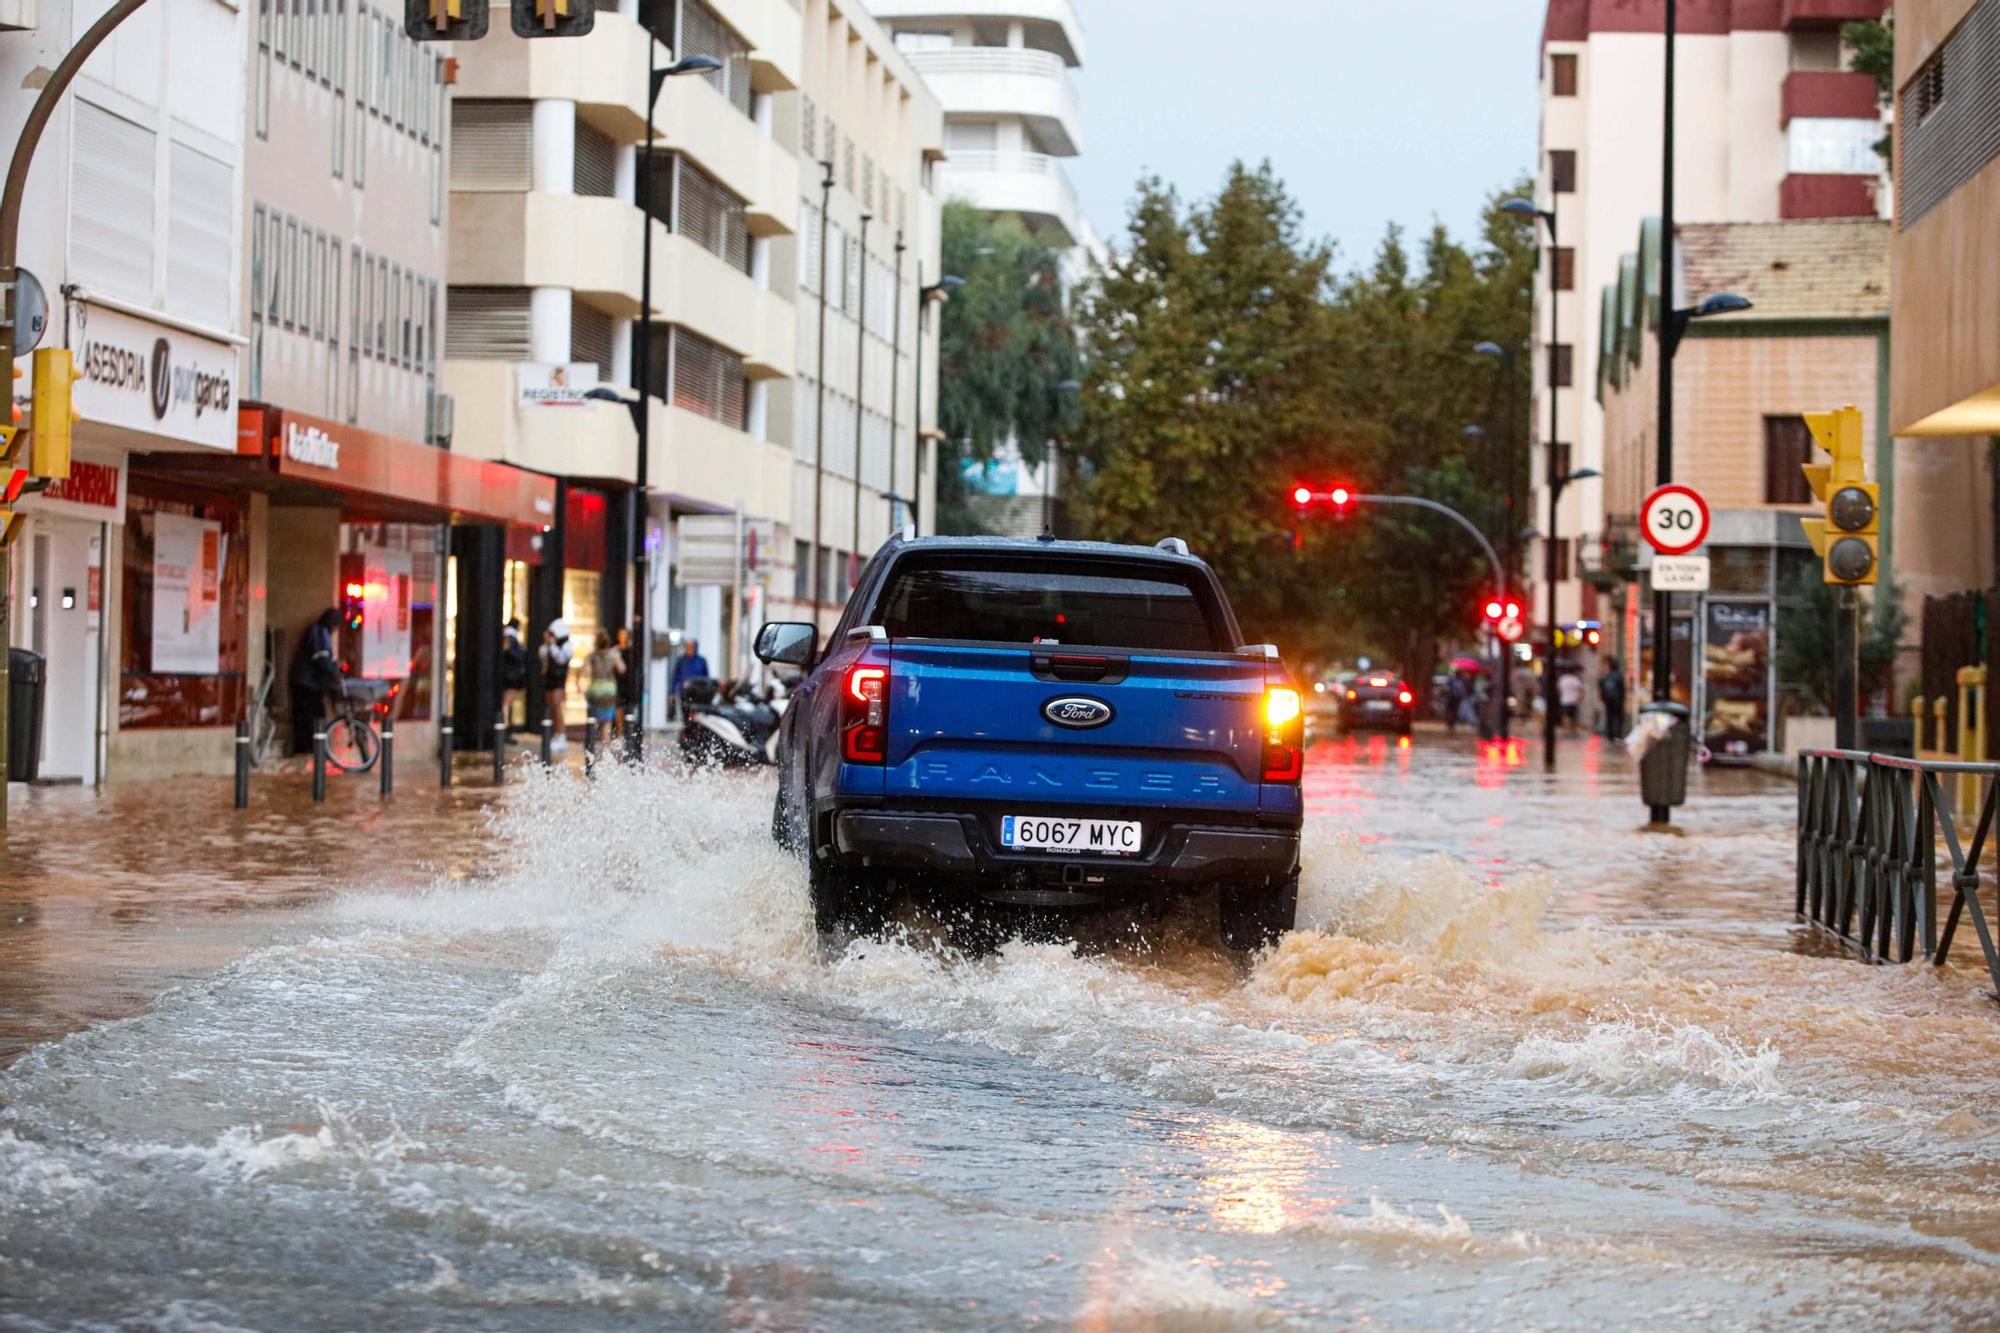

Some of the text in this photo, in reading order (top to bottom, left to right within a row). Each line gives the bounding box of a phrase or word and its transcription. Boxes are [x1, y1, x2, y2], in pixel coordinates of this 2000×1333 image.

[84, 341, 146, 392] ASESORIA
[1658, 508, 1694, 530] 30
[1060, 703, 1096, 720] Ford
[920, 763, 1226, 794] RANGER
[1020, 821, 1134, 847] 6067 MYC
[1046, 847, 1081, 855] ROMACAR
